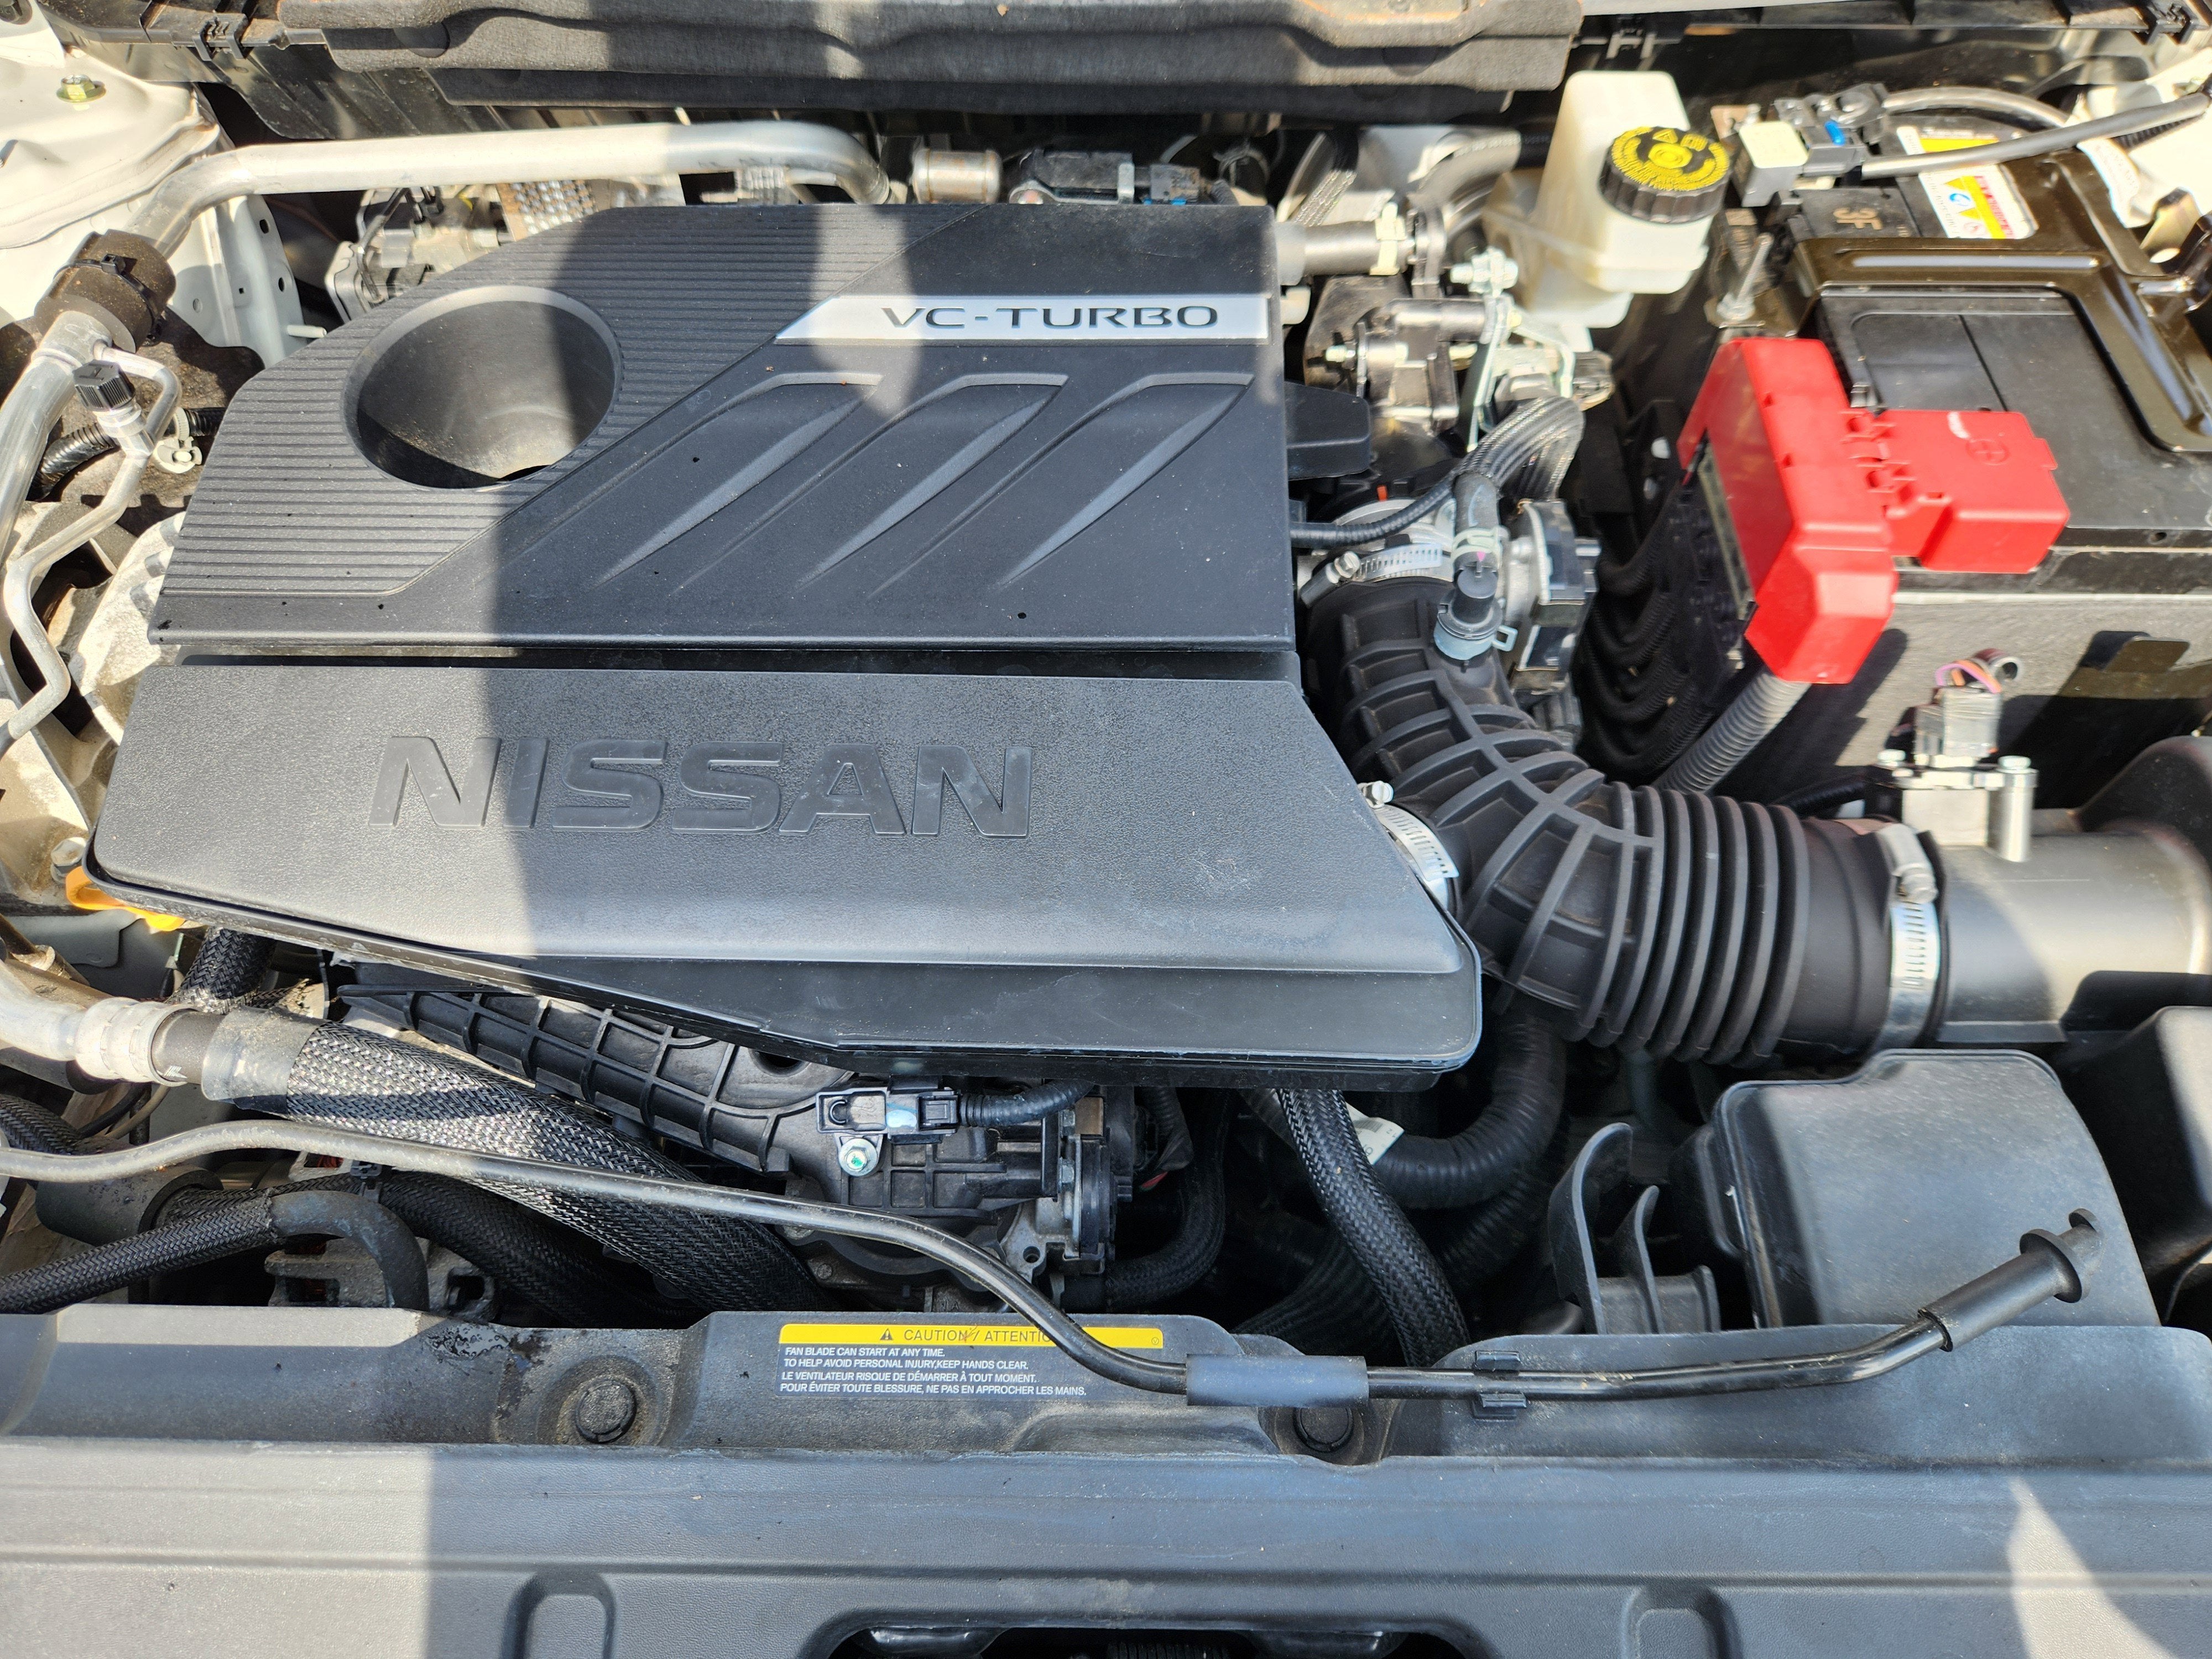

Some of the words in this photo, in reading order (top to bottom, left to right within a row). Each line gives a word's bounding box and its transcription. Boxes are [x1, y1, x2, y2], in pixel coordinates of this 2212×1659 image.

[881, 305, 1218, 329] VC-TURBO
[368, 736, 1033, 839] NISSAN
[904, 1329, 968, 1341] CAUTION
[785, 1347, 803, 1355] FAN
[805, 1347, 835, 1355] BLADE
[837, 1347, 857, 1356] CAN
[858, 1348, 888, 1356] START
[888, 1348, 901, 1357] AT
[901, 1348, 922, 1357] ANY
[922, 1348, 946, 1357] TIME.
[784, 1358, 797, 1367] TO
[798, 1358, 823, 1368] HELP
[823, 1359, 852, 1368] AVOID
[853, 1359, 903, 1368] PERSONAL
[961, 1360, 994, 1369] HANDS
[997, 1360, 1029, 1370] CLEAR.
[781, 1371, 794, 1380] LE
[795, 1371, 854, 1380] VENTILATEUR
[855, 1372, 891, 1381] RISQUE
[892, 1373, 906, 1381] DE
[907, 1370, 958, 1381] DÉMARRER
[968, 1373, 993, 1382] TOUT
[995, 1374, 1037, 1383] MOMENT.
[780, 1383, 807, 1392] POUR
[808, 1381, 840, 1392] ÉVITER
[842, 1384, 872, 1392] TOUTE
[873, 1384, 925, 1395] BLESSURE,
[926, 1385, 940, 1394] NE
[941, 1385, 959, 1394] PAS
[961, 1385, 974, 1394] EN
[975, 1385, 1034, 1395] APPROCHER
[1036, 1386, 1053, 1395] LES
[1055, 1386, 1087, 1396] MAINS.
